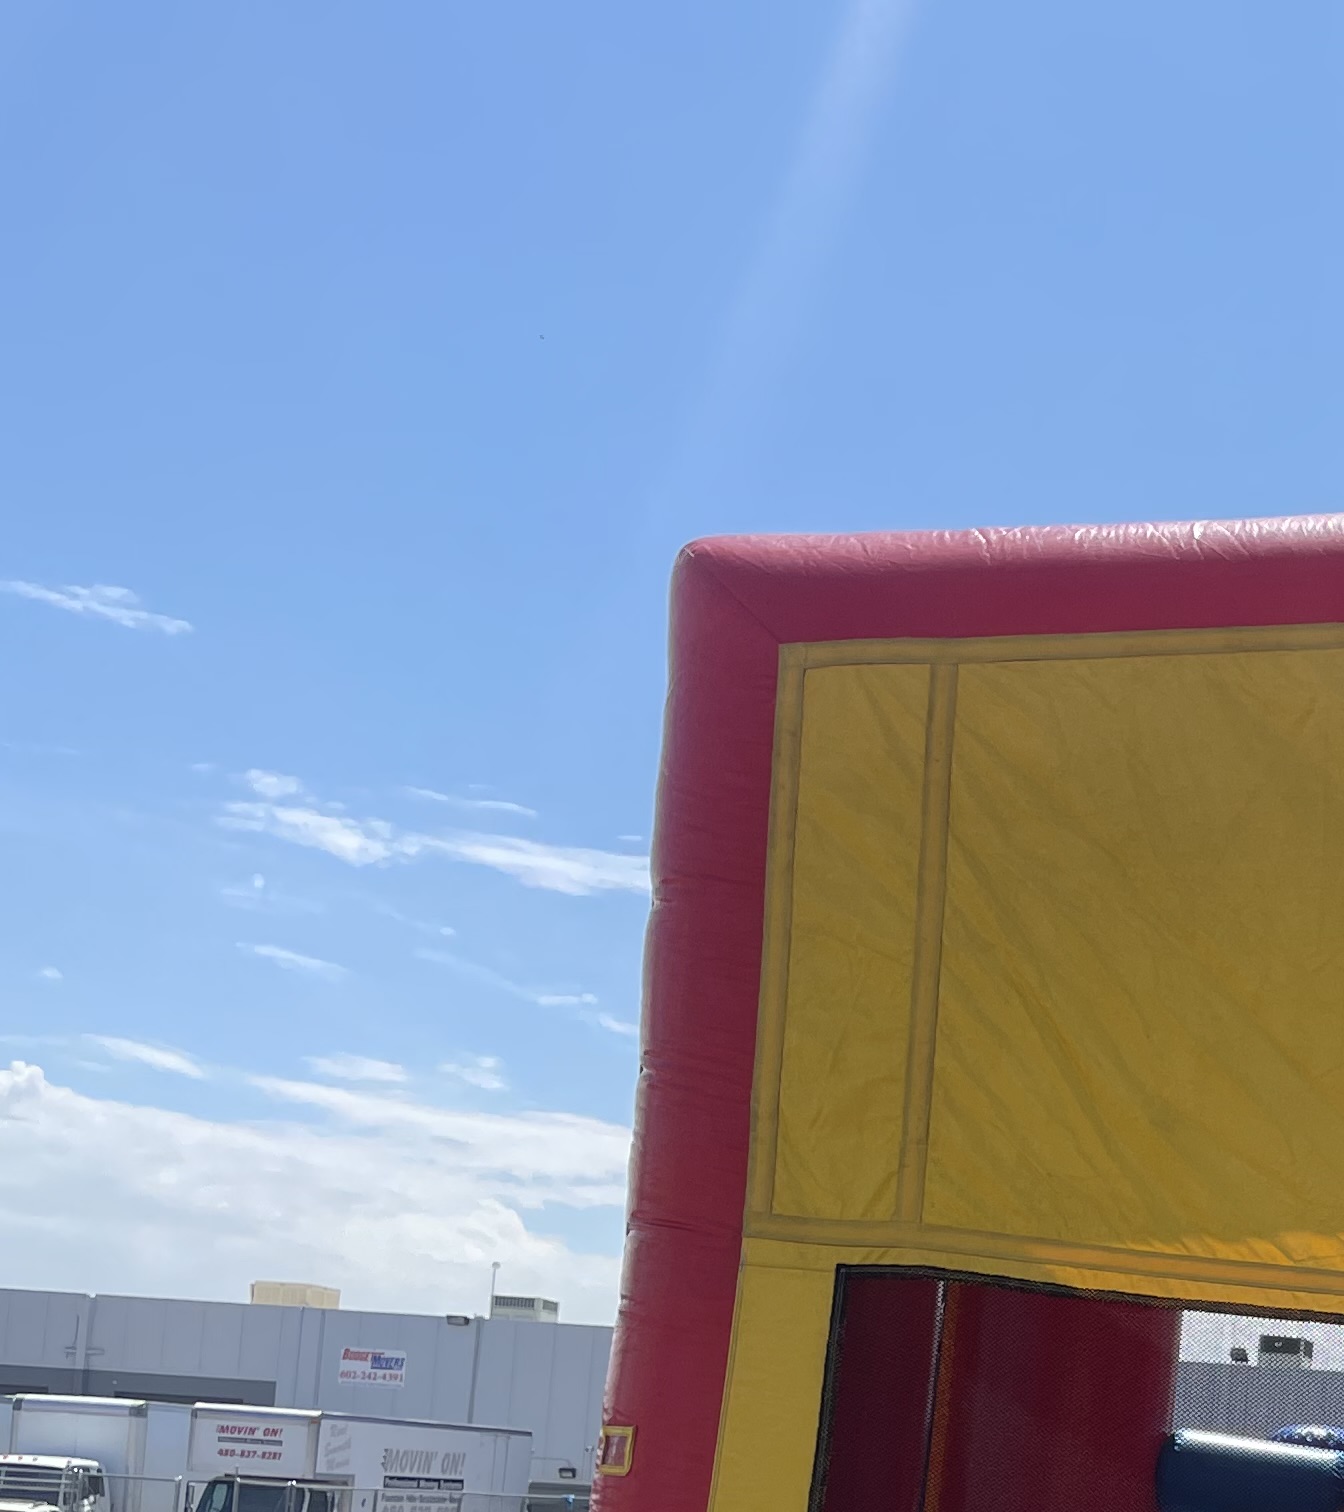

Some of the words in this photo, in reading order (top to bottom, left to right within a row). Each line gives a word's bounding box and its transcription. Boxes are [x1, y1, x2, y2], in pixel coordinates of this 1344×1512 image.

[217, 1425, 260, 1436] MOVIN'
[263, 1428, 283, 1437] ON!
[384, 1449, 439, 1474] MOVIN'
[441, 1452, 466, 1476] ON!
